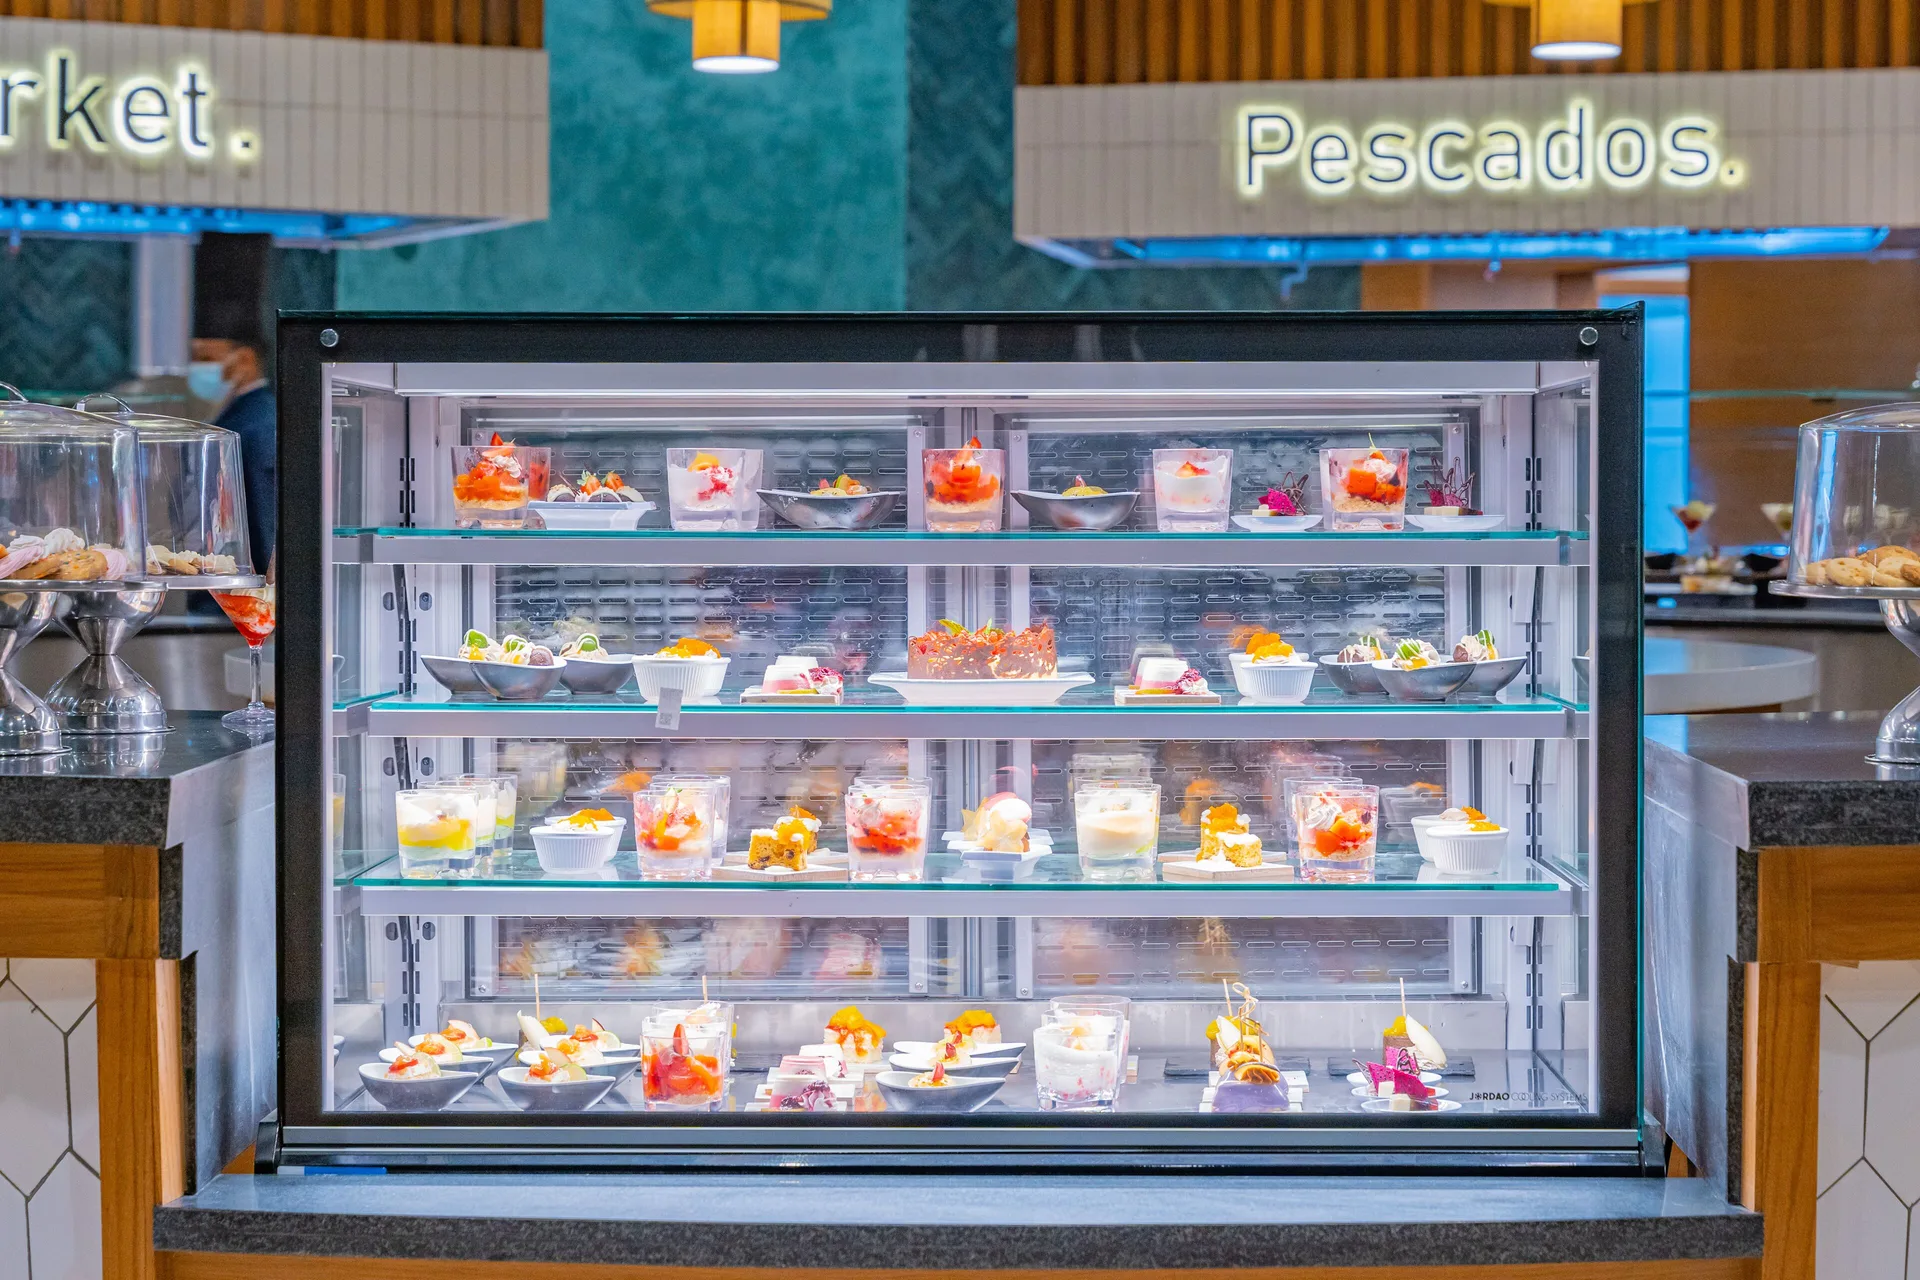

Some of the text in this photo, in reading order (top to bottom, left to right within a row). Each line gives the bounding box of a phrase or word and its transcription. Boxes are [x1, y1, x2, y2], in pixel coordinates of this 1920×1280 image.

[0, 56, 251, 151] rket.
[1244, 104, 1739, 189] Pescados.
[1511, 1092, 1549, 1101] COOLNG
